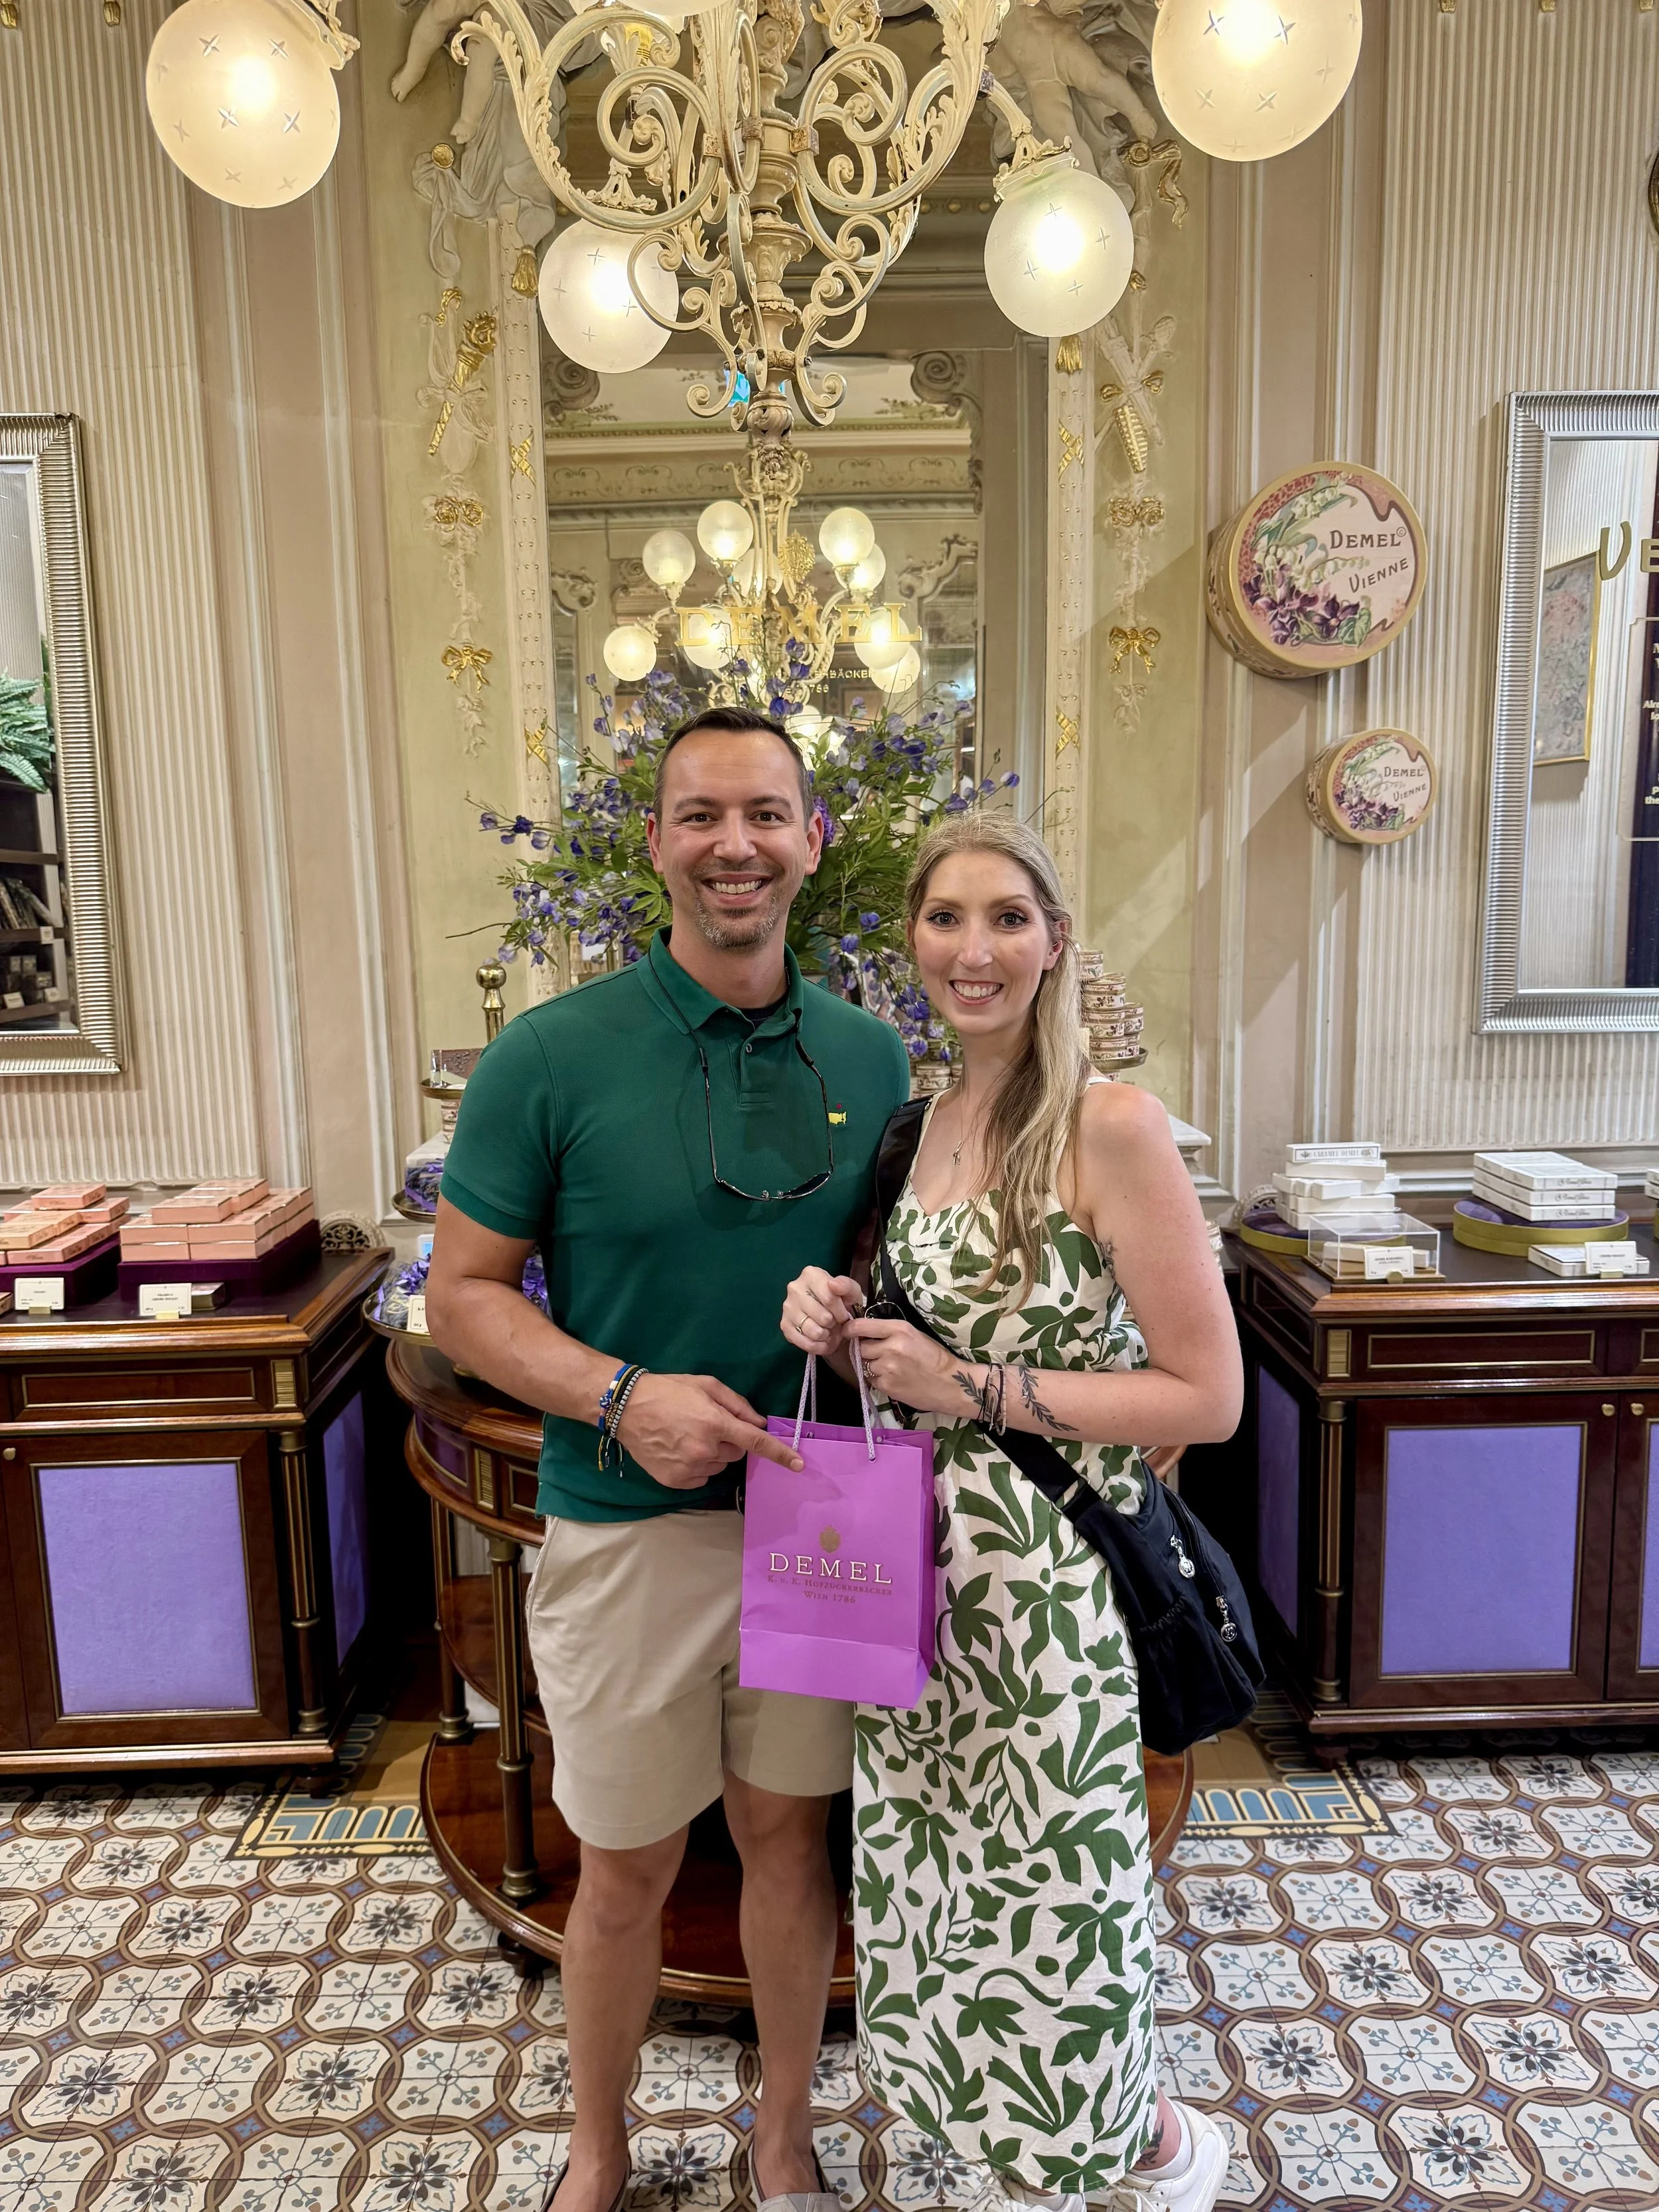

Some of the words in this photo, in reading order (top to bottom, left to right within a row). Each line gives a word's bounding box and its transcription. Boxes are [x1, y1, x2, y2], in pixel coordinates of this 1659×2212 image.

[1348, 557, 1409, 593] VIENNE
[674, 603, 922, 646] DEMEL
[1384, 766, 1423, 777] DEMEL
[1393, 783, 1427, 802] VIENNE
[769, 1552, 893, 1584] DEMEL
[833, 1593, 856, 1603] 1786
